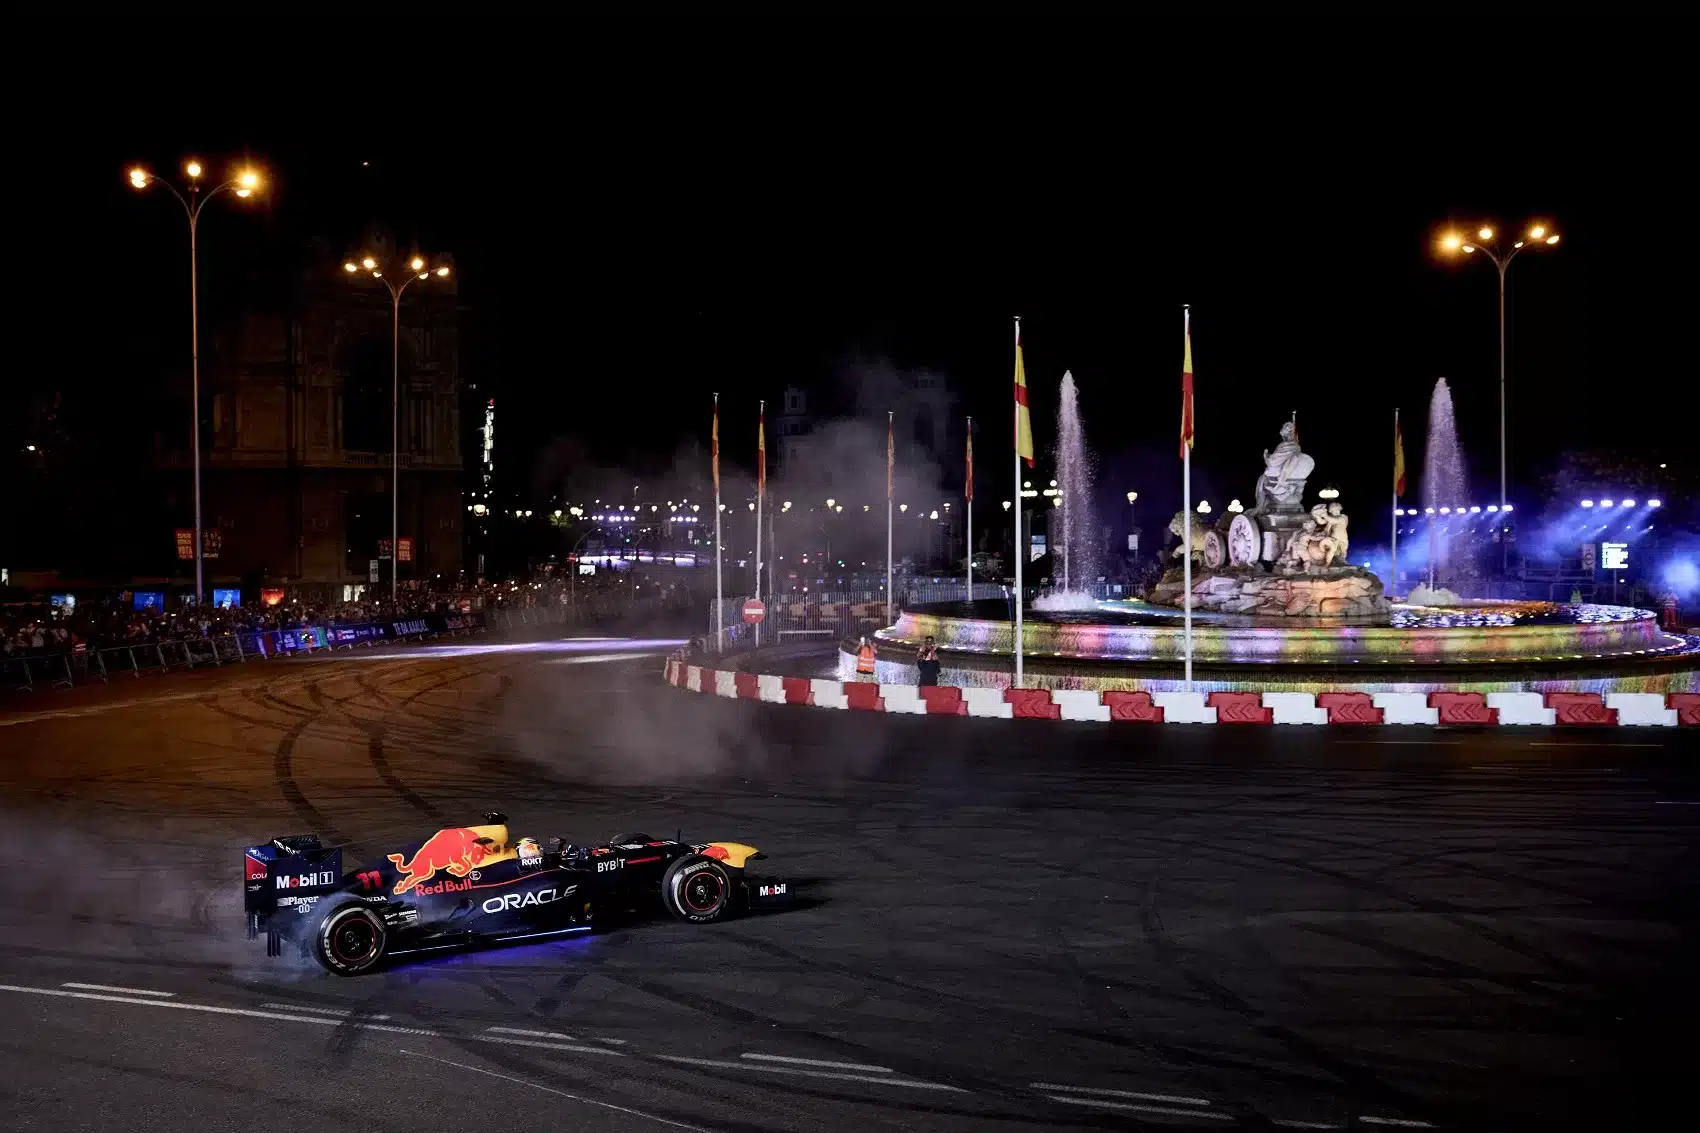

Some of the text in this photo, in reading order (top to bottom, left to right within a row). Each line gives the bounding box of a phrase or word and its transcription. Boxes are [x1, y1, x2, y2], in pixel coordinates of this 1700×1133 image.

[521, 857, 543, 866] ROKT
[597, 857, 626, 873] BYBIT
[276, 873, 318, 890] Mobil
[356, 870, 383, 889] 11
[415, 874, 473, 896] Red Bull
[759, 883, 786, 897] Mobil
[288, 895, 319, 906] Player
[482, 884, 578, 914] ORACLE
